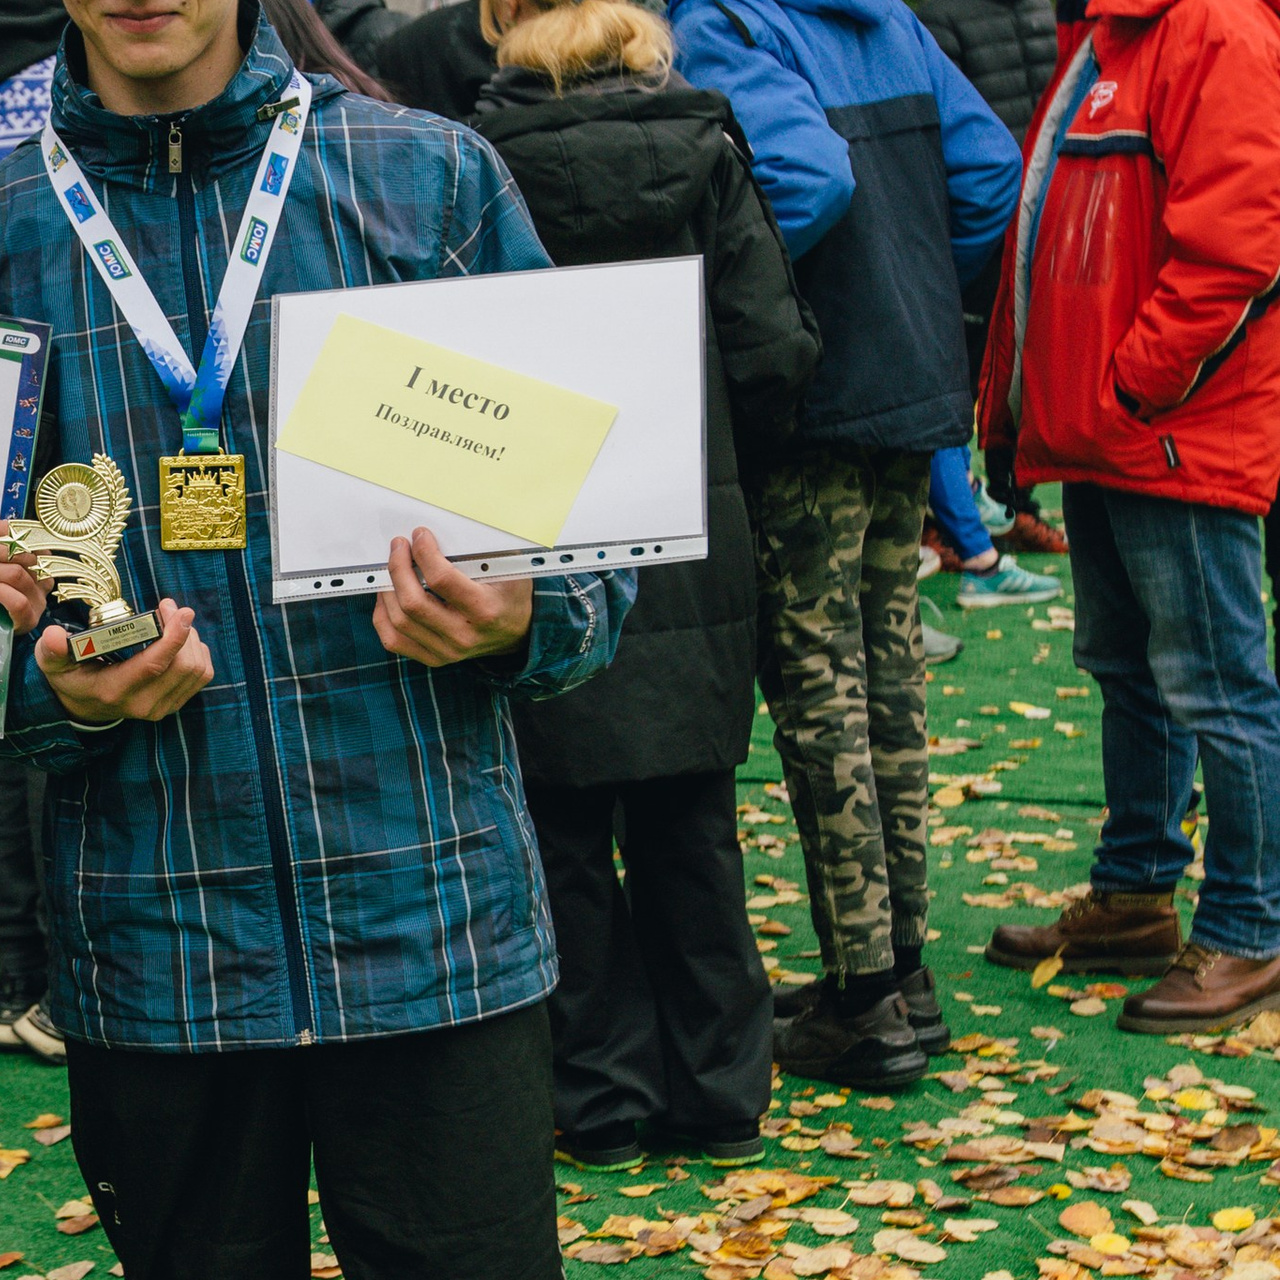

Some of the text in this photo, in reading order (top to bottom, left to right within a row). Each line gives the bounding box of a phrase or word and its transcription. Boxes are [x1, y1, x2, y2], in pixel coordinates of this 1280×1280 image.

[246, 221, 266, 261] ЮМС
[99, 244, 124, 277] ЮМС
[6, 336, 27, 347] ЮМС
[404, 365, 511, 422] I место
[374, 402, 506, 462] Поздравляем!
[112, 622, 135, 635] МЕСТО
